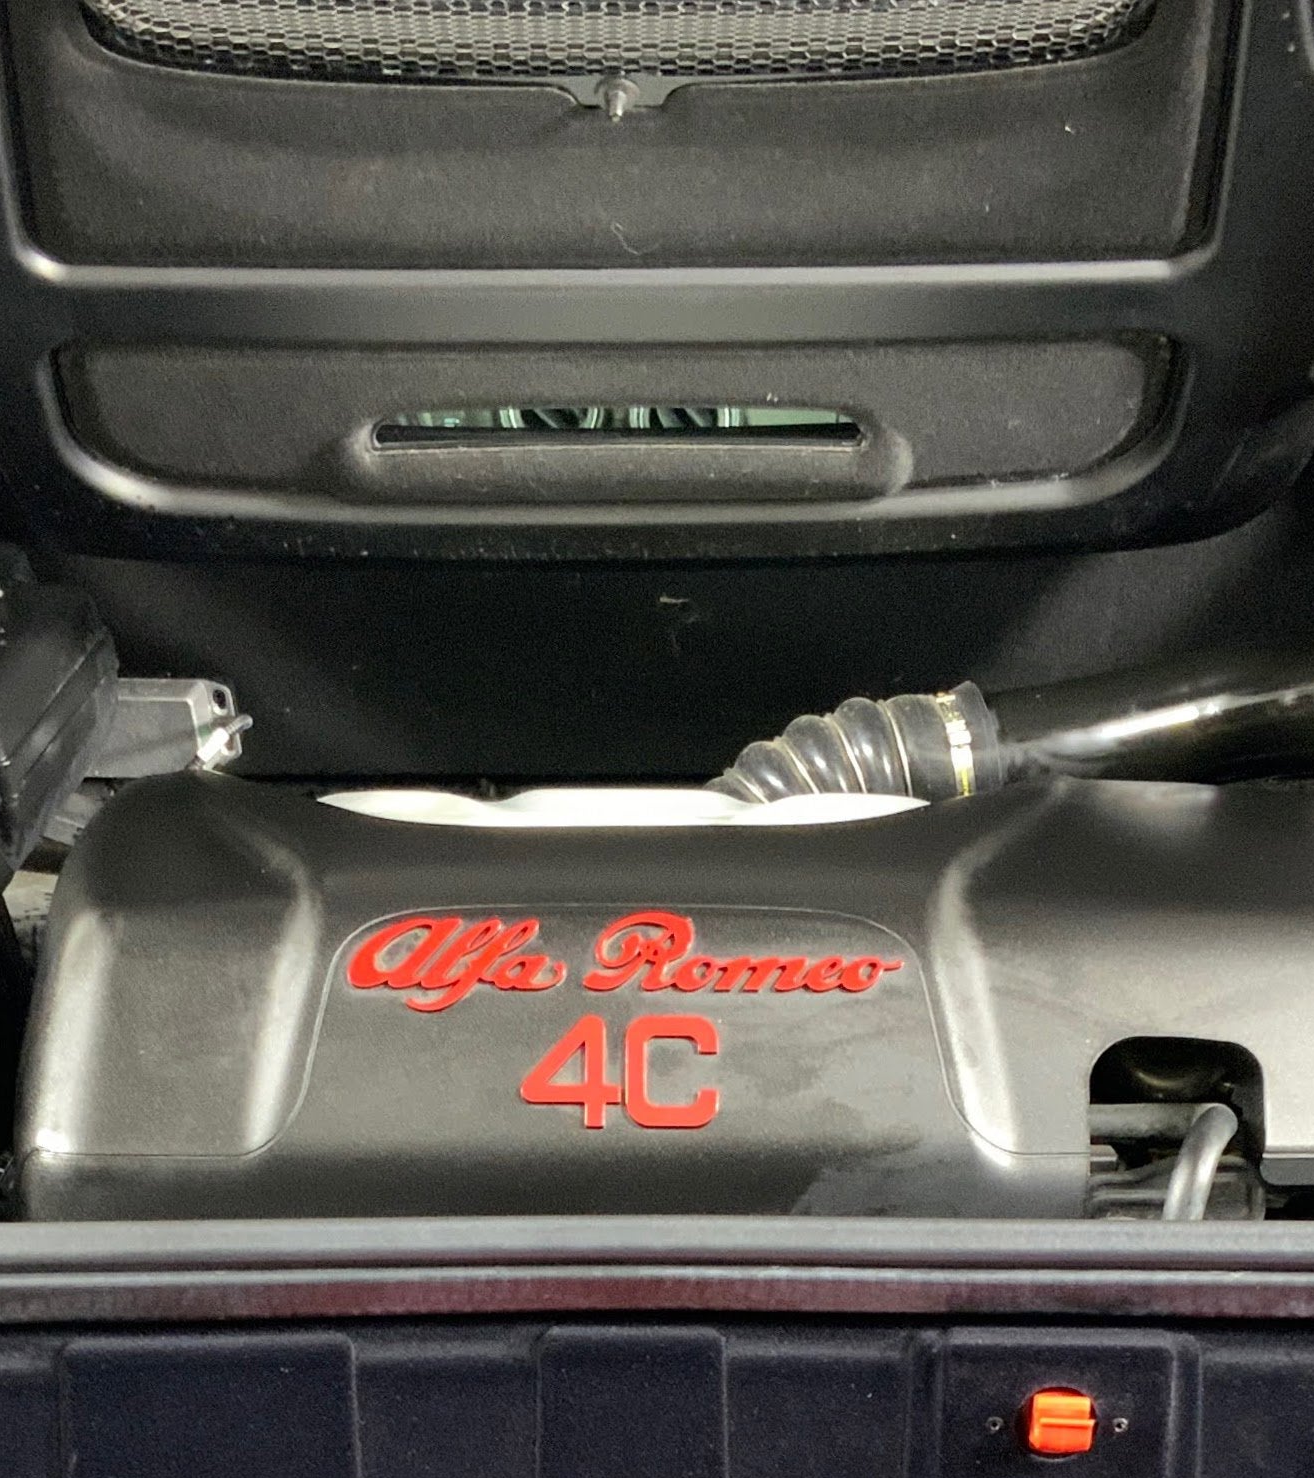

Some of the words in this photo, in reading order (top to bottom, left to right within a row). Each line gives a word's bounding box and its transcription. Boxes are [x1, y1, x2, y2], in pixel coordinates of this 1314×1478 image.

[346, 914, 567, 1014] Alfa
[581, 908, 903, 994] Romeo
[519, 1013, 720, 1130] 4C
